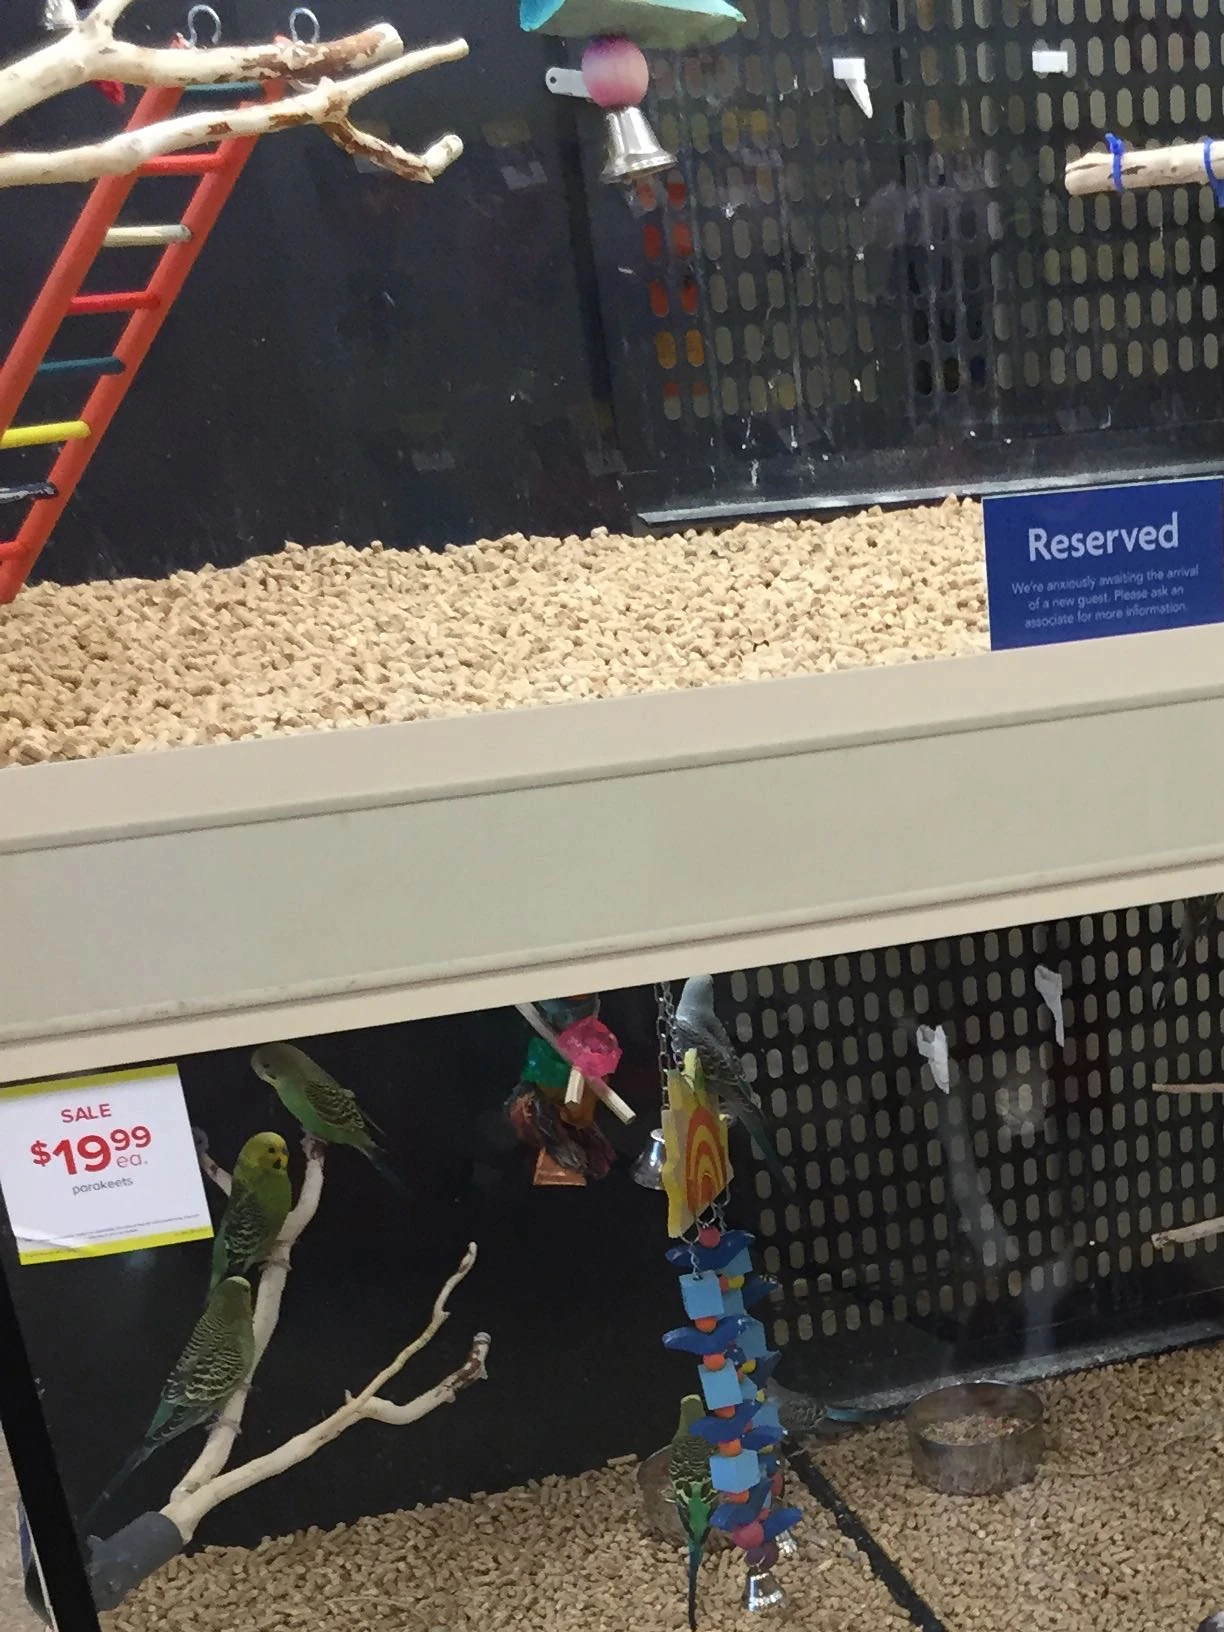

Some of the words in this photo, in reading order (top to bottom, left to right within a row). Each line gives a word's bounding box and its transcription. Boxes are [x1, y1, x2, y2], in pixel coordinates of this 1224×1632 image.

[1028, 511, 1179, 562] Reserved
[1011, 582, 1044, 595] We're
[1047, 575, 1096, 591] anxiously
[1099, 571, 1144, 586] awaiting
[1147, 569, 1164, 580] the
[1167, 563, 1199, 579] arrival
[1028, 597, 1040, 611] of
[1042, 600, 1050, 608] a
[1052, 597, 1075, 608] new
[1114, 588, 1149, 601] Please
[1151, 585, 1168, 598] ask
[1171, 586, 1184, 597] an
[1025, 613, 1074, 629] associate
[1077, 609, 1092, 622] for
[1095, 610, 1123, 620] more
[60, 1103, 112, 1123] SALE
[117, 1153, 148, 1168] ea.
[72, 1176, 134, 1195] parakeets
